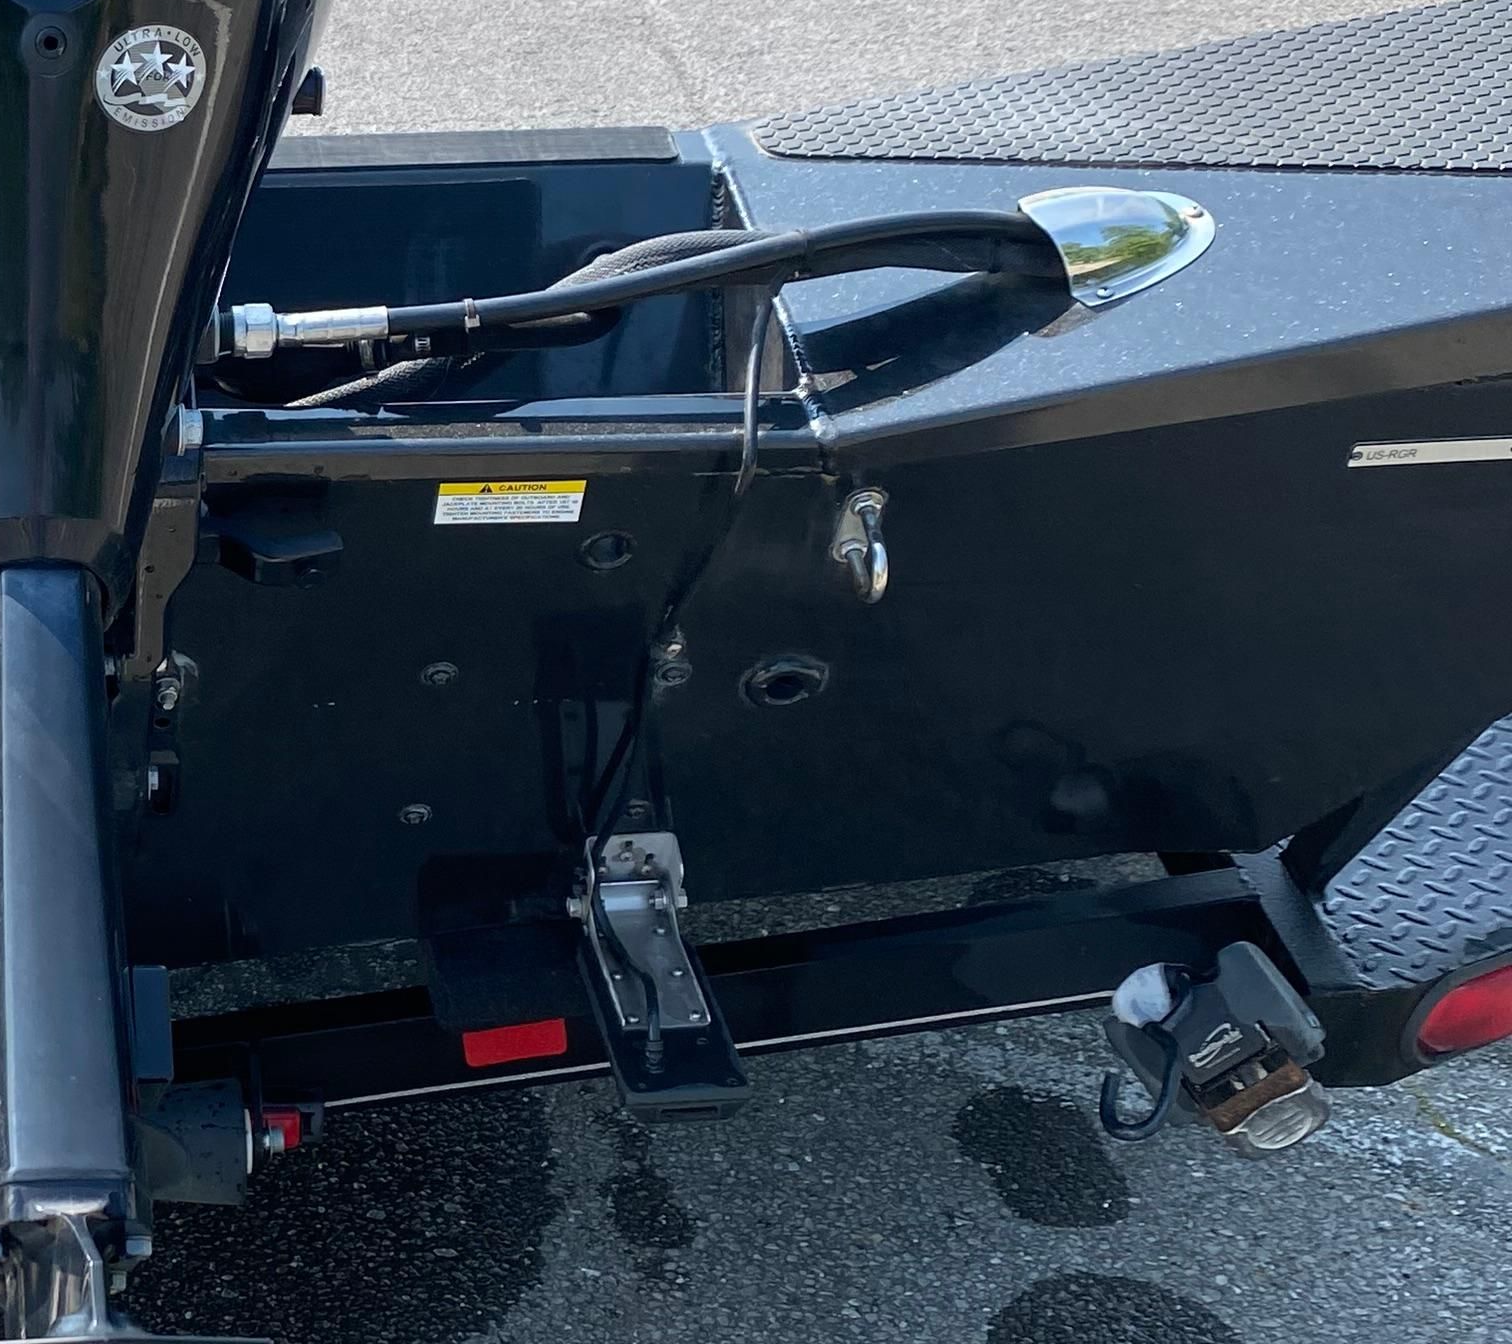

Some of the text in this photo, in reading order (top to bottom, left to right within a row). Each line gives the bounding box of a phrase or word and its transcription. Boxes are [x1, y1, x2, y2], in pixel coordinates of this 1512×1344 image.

[114, 28, 201, 57] ULTRA LOW
[113, 107, 186, 128] EMISSION
[1365, 448, 1418, 461] US-RGR
[498, 483, 547, 492] CAUTION
